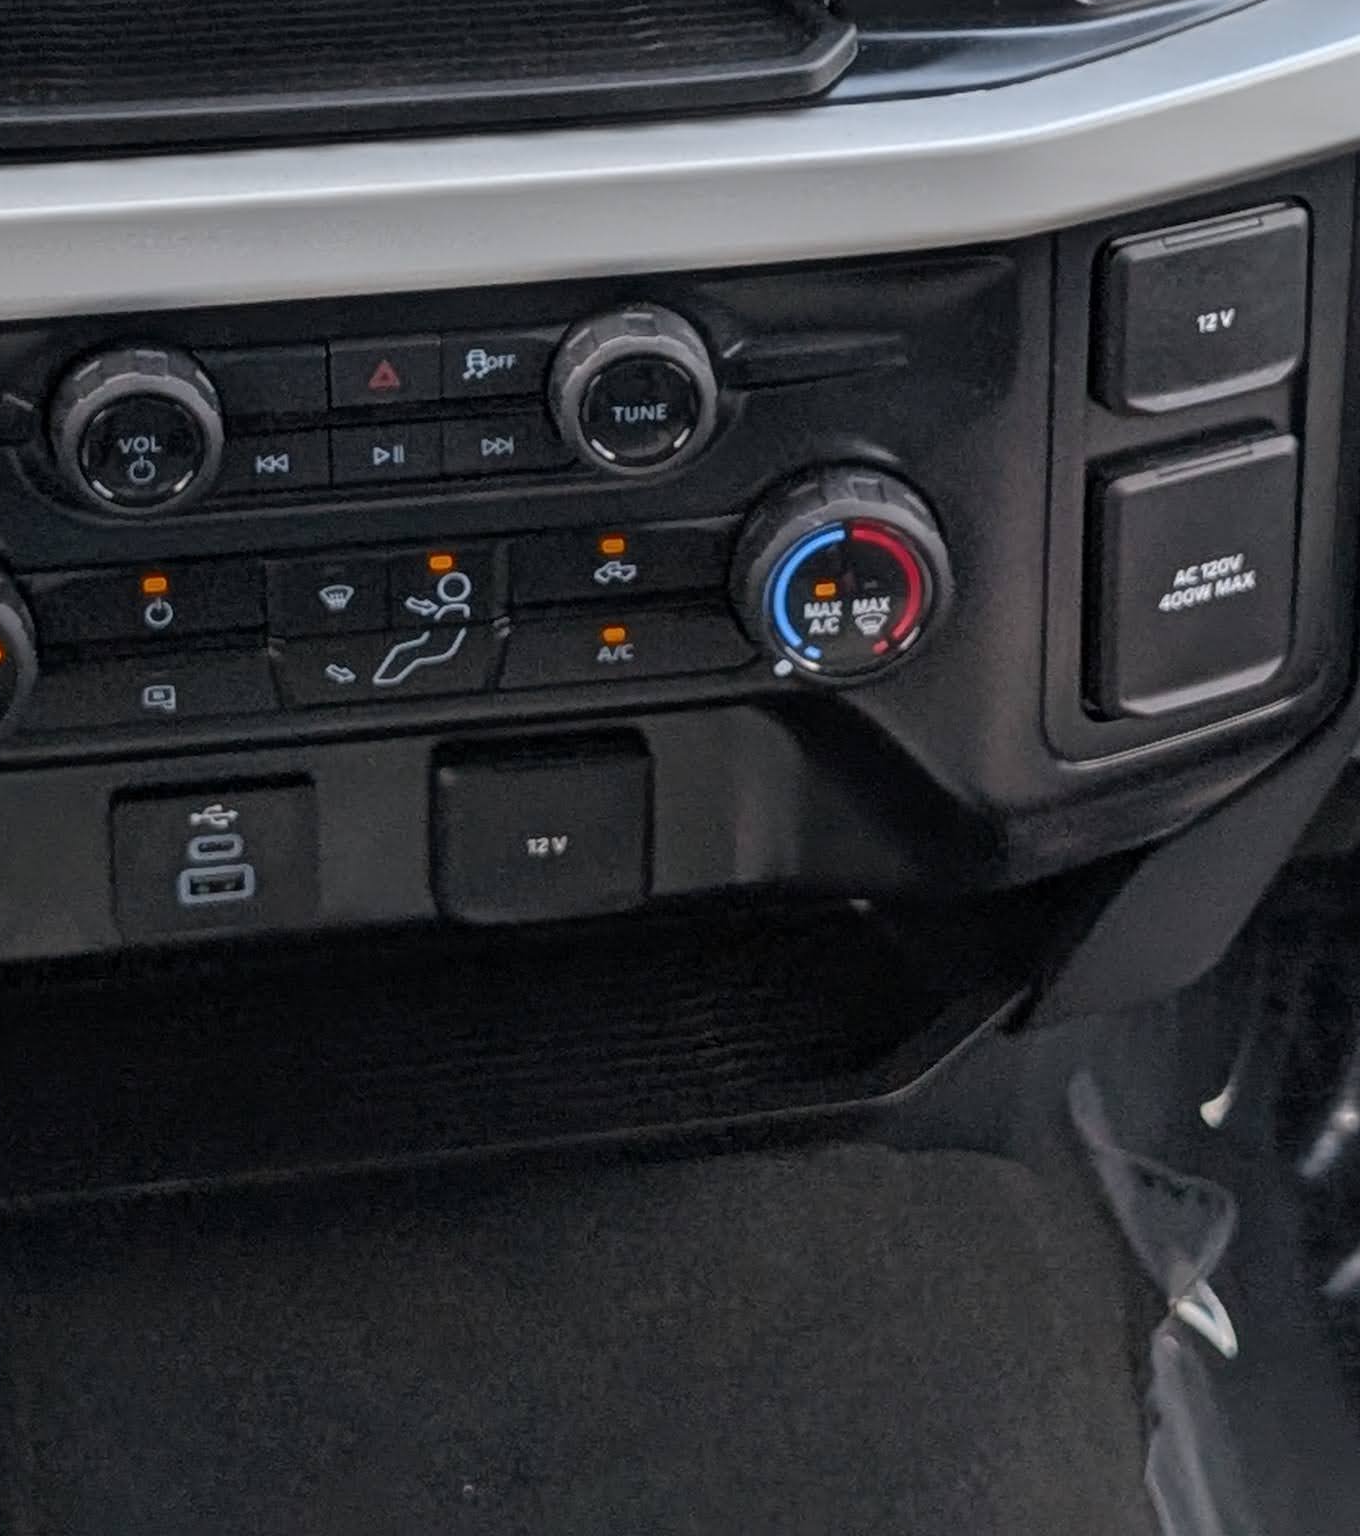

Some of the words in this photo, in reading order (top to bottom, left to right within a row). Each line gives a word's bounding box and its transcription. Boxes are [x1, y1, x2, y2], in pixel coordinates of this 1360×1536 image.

[1196, 312, 1218, 334] 12
[1219, 307, 1236, 329] V
[488, 351, 516, 371] OFF
[611, 403, 668, 423] TUNE
[119, 436, 161, 455] VOL
[1173, 565, 1200, 590] AC
[1200, 553, 1244, 582] 120V
[1158, 582, 1213, 611] 400W
[1214, 570, 1256, 598] MAX
[803, 600, 842, 619] MAX
[852, 596, 890, 615] MAX
[809, 616, 839, 635] A/C
[596, 644, 635, 662] A/C
[527, 837, 549, 857] 12
[552, 835, 568, 855] V
